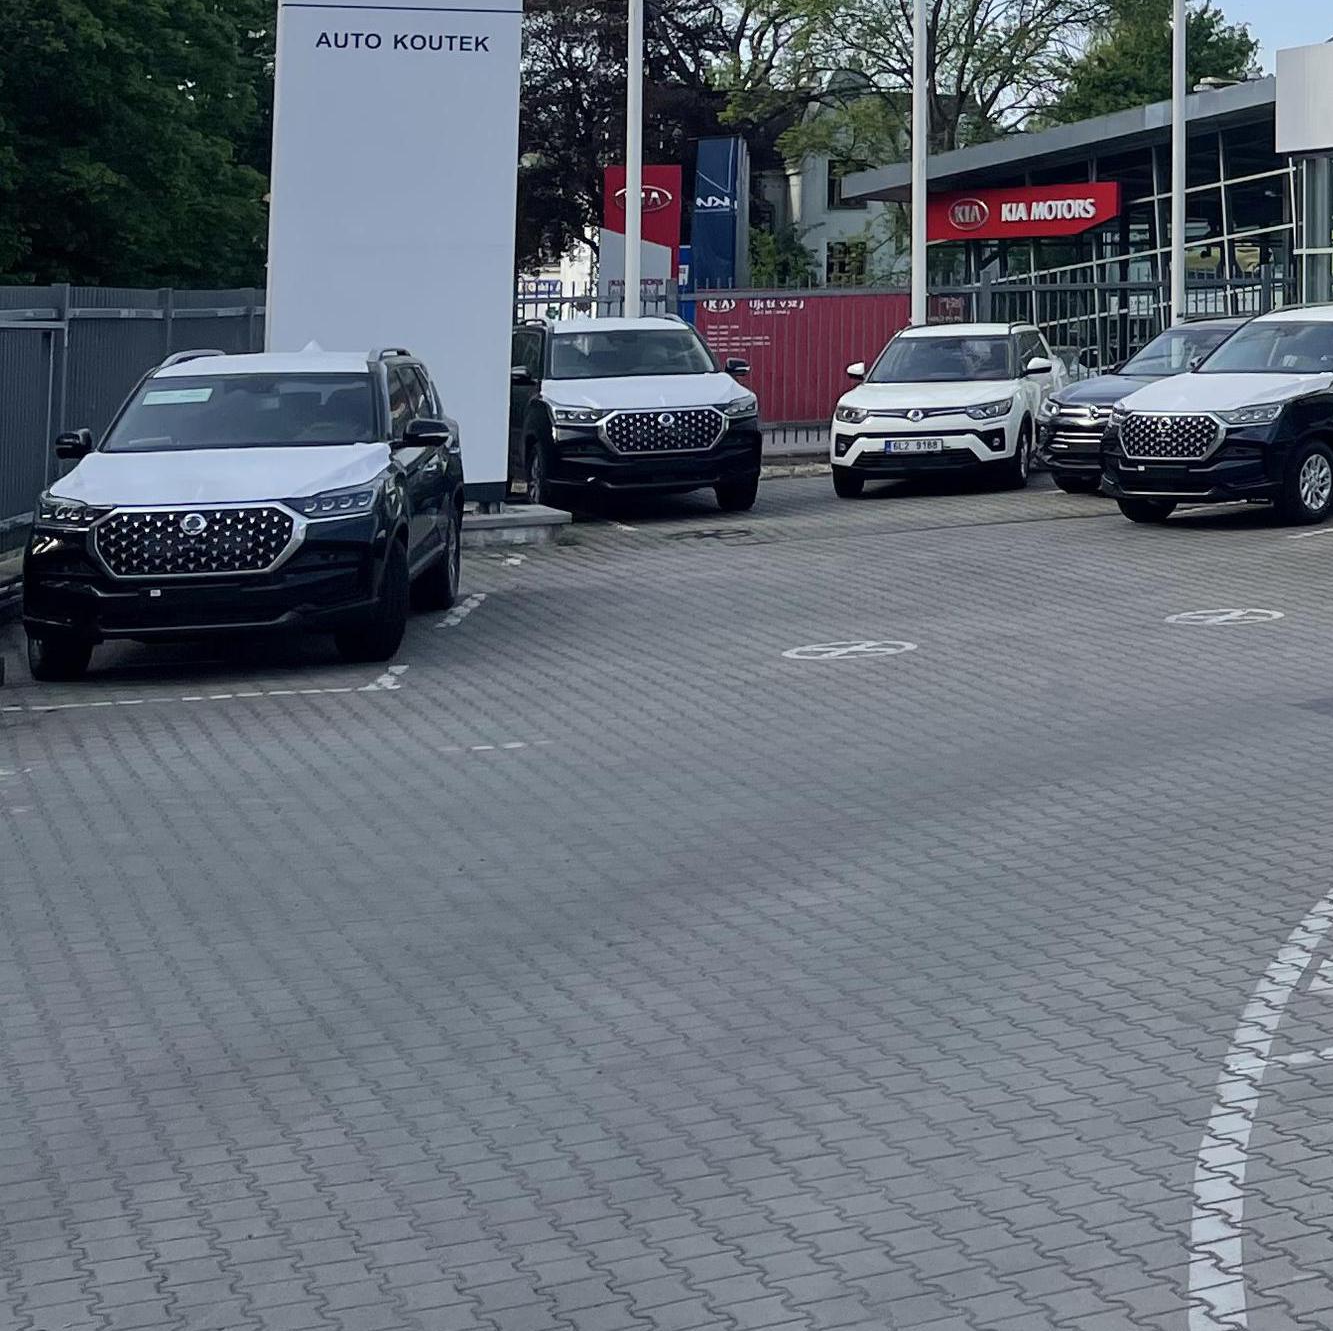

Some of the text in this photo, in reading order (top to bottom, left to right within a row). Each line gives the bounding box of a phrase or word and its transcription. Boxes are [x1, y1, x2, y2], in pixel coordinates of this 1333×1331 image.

[315, 32, 490, 52] AUTO KOUTEK
[954, 204, 980, 223] KIA
[1001, 198, 1096, 222] KIA MOTORS
